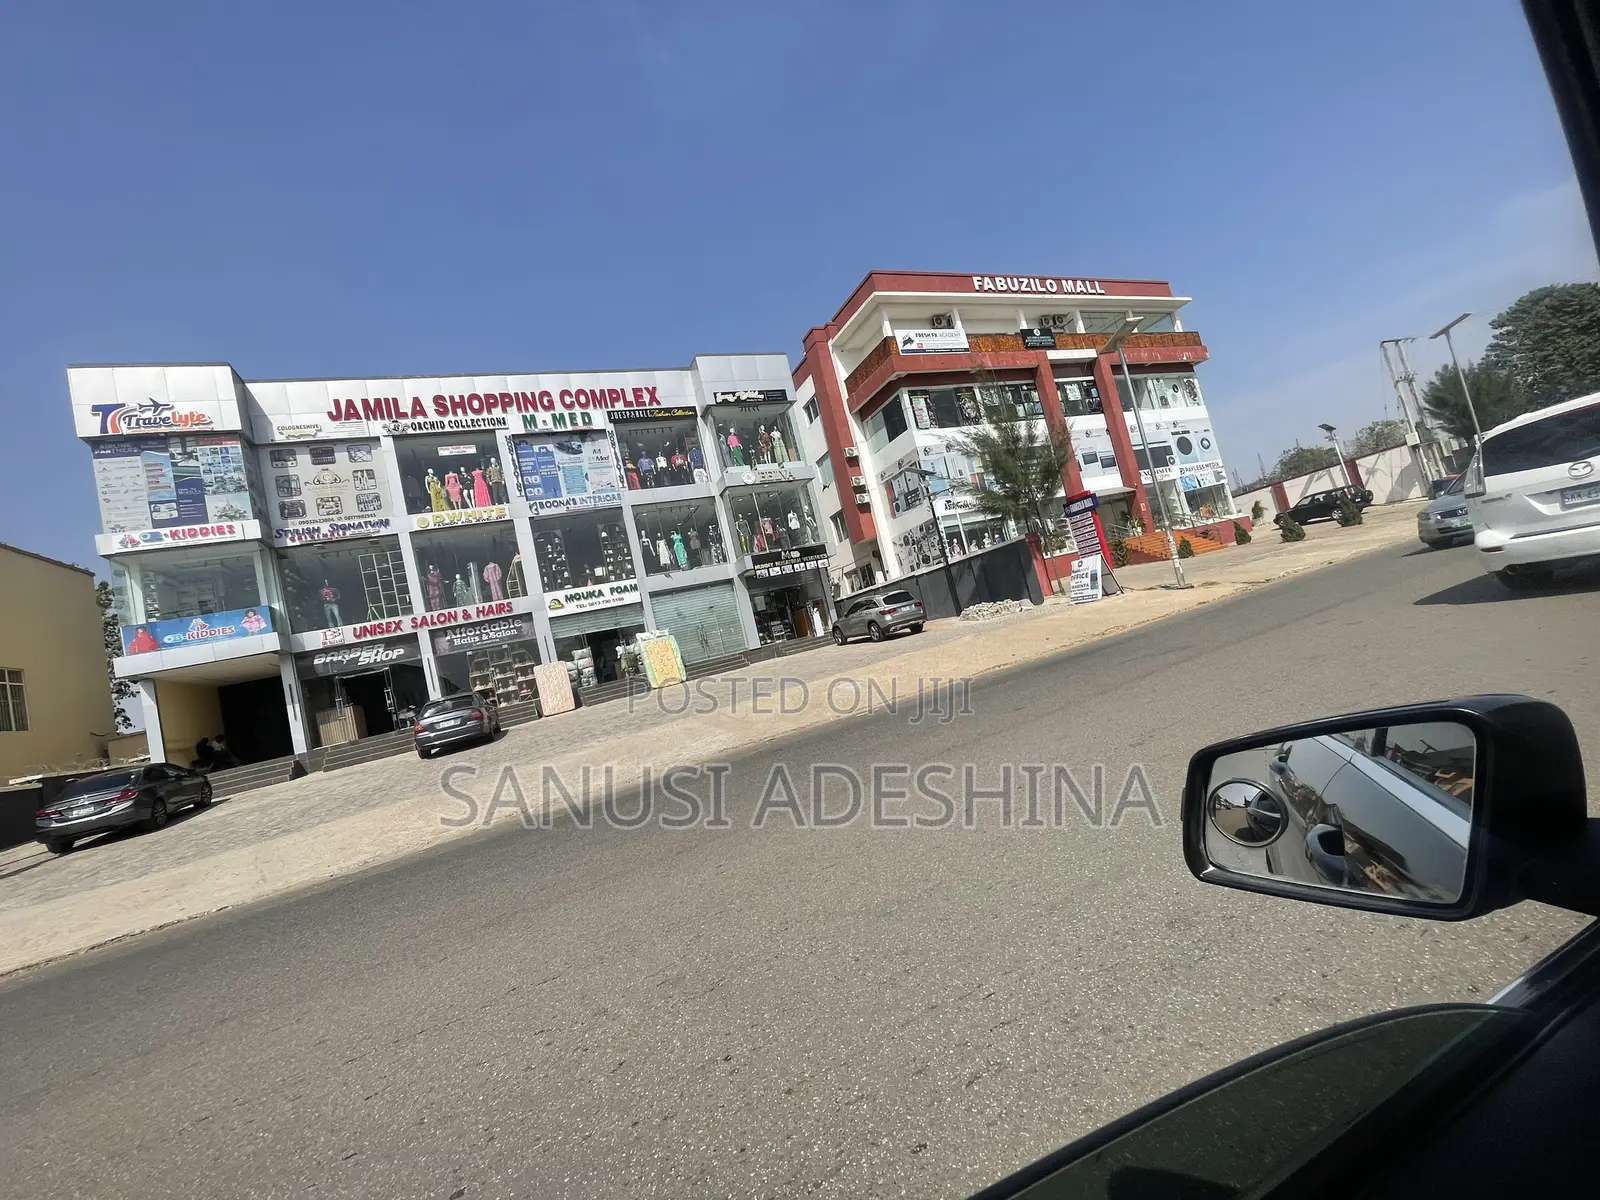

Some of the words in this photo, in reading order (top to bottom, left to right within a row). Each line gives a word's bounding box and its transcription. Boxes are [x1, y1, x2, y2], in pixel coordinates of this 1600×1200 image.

[972, 276, 1058, 293] FABUZILO
[1061, 279, 1105, 294] MALL
[327, 396, 429, 421] JAMILA
[432, 390, 556, 418] SHOPPING
[559, 386, 662, 410] COMPLEX
[123, 411, 210, 428] Travelyte
[410, 420, 446, 432] ORCHID
[448, 416, 507, 429] COLLECTIONS
[610, 410, 651, 421] JOESPARKLE
[277, 423, 320, 431] COLOGNESHIVE
[1185, 463, 1206, 472] PAYLESS
[539, 496, 577, 509] BOONA'S
[580, 493, 622, 504] INTERIORS
[275, 526, 321, 538] STYLISH
[564, 589, 606, 604] MOUKA
[609, 583, 638, 596] FOAM
[352, 620, 403, 640] UNISEX
[410, 611, 458, 629] SALON
[462, 609, 473, 620] &
[475, 602, 514, 618] HAIRS
[446, 619, 523, 640] Affordable
[453, 634, 480, 646] Hairs
[489, 628, 518, 639] Salon
[357, 648, 405, 666] SHOP
